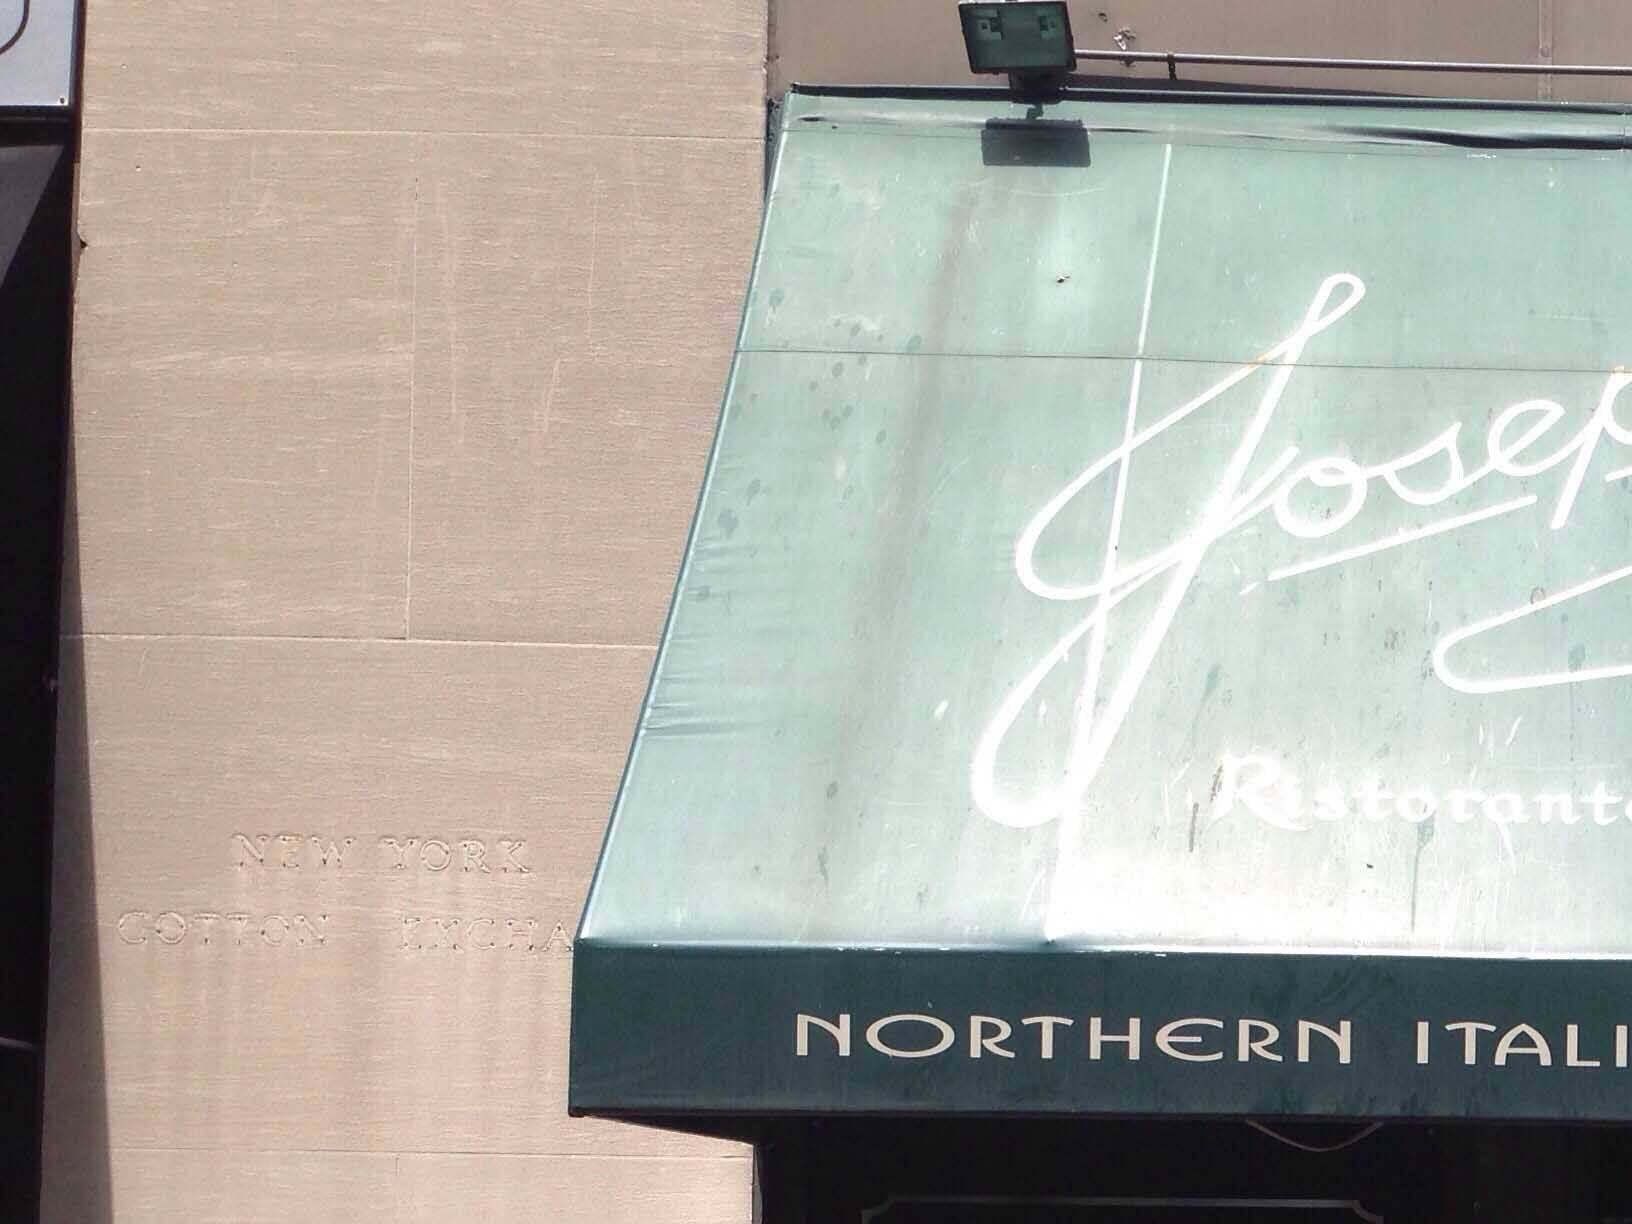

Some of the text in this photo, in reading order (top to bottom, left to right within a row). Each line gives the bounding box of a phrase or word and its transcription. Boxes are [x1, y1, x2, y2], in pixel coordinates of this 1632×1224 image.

[233, 834, 531, 874] NEW YORK
[118, 911, 328, 946] COTTON
[796, 1013, 1351, 1065] NORTHERN
